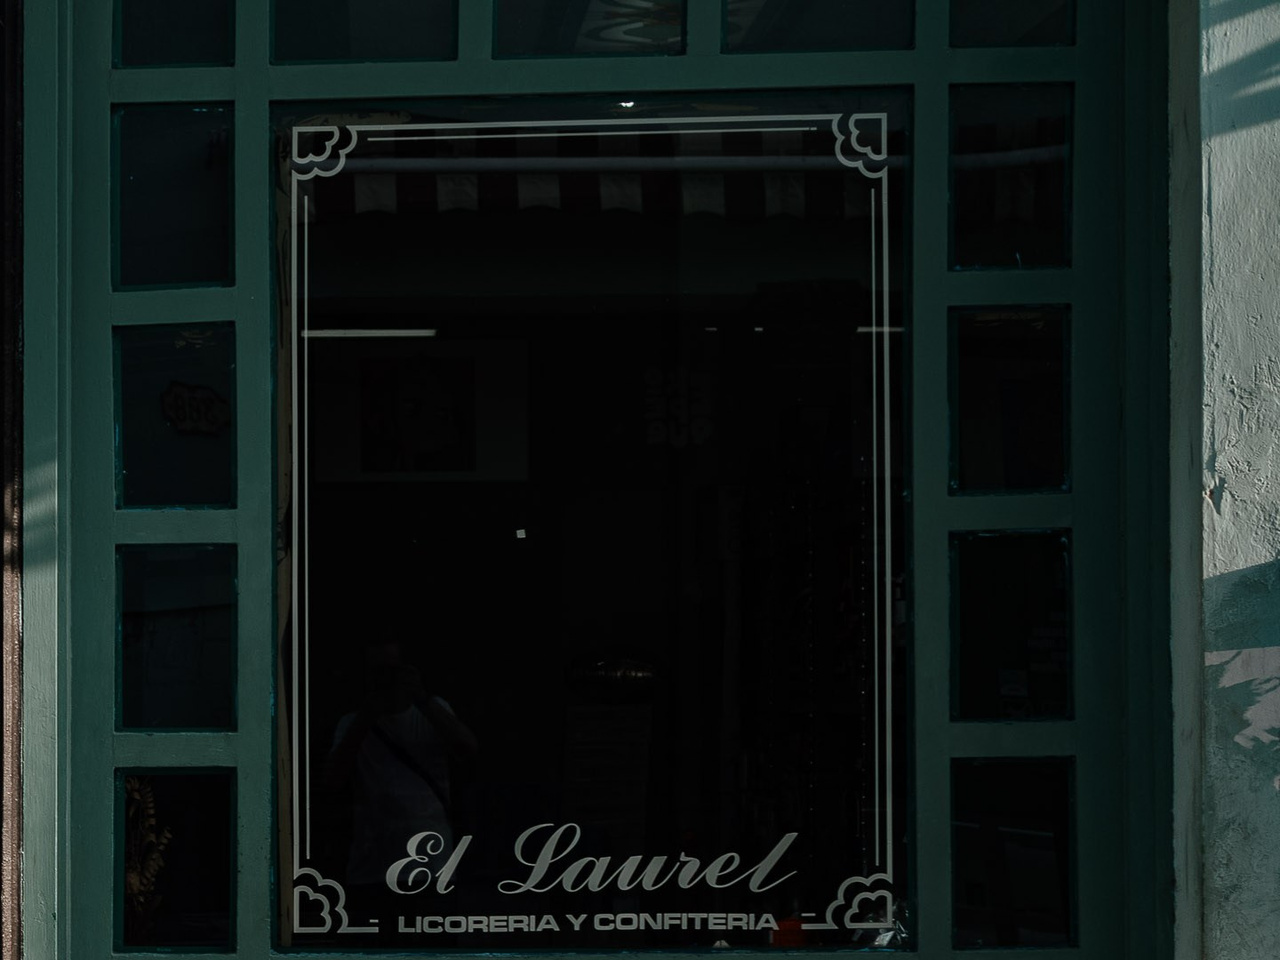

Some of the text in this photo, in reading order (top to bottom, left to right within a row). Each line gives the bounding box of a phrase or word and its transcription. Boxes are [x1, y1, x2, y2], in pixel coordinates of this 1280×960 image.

[385, 822, 799, 895] El Laurel
[398, 912, 779, 933] LICORERIA Y CONFITERIA
